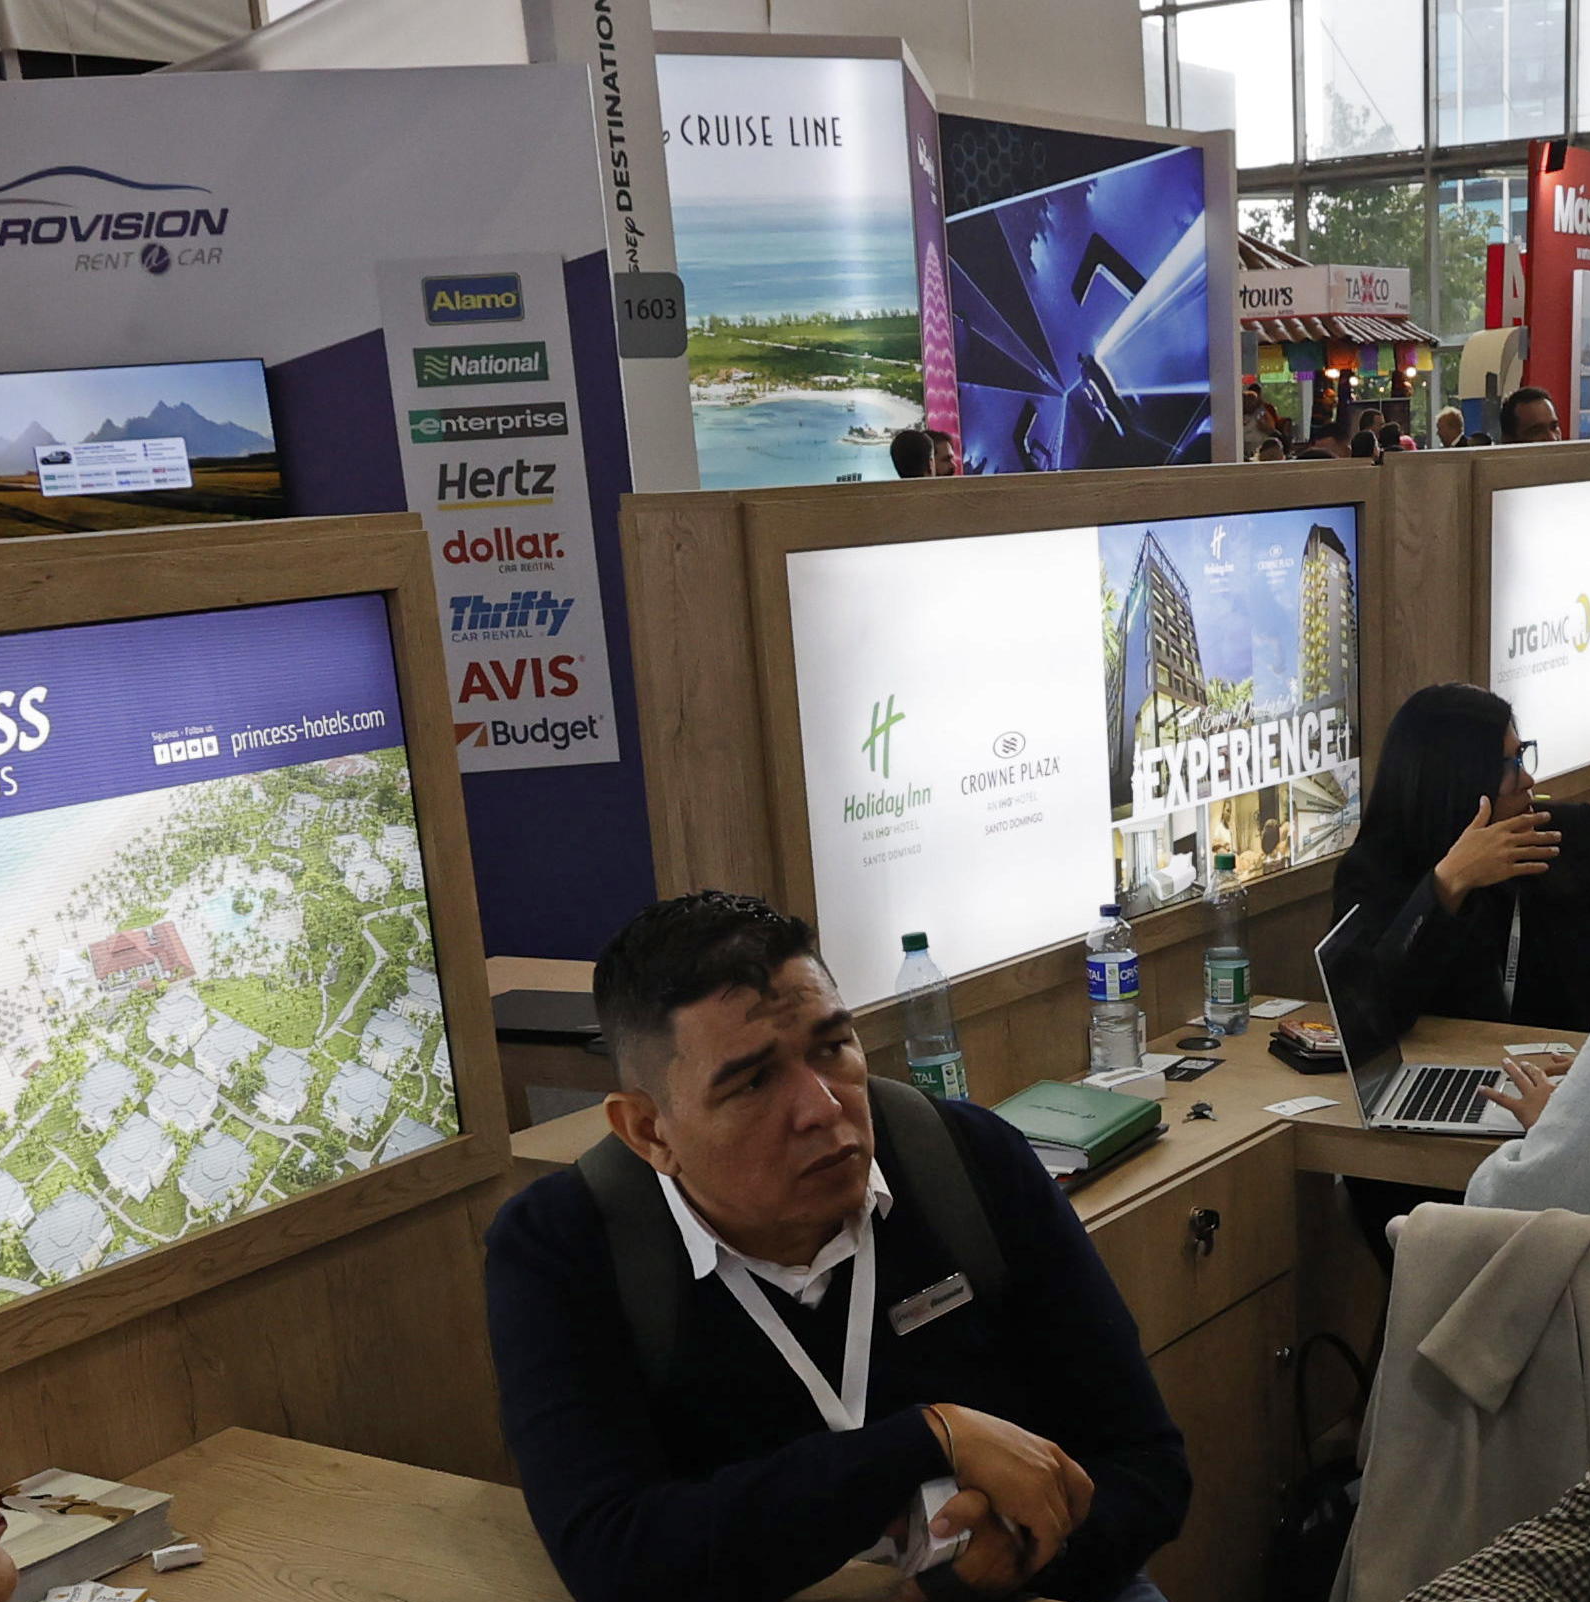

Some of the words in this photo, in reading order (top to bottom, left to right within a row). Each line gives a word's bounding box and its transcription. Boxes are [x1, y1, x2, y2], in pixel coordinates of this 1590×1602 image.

[680, 114, 774, 147] CRUISE
[789, 115, 843, 147] LINE
[75, 251, 134, 272] RENT
[177, 246, 223, 267] CAR
[432, 290, 517, 311] Alamo
[624, 298, 677, 321] 1603
[1238, 283, 1293, 309] tours
[449, 351, 540, 377] National
[413, 409, 565, 436] enterprise
[437, 459, 557, 501] Hertz
[498, 565, 519, 574] CAR
[520, 562, 556, 572] RENTAL
[449, 590, 575, 637] Thrifty
[451, 630, 479, 643] CAR
[482, 627, 533, 641] RENTAL
[1507, 623, 1539, 660] JTG
[1541, 614, 1570, 650] DMC
[458, 654, 580, 704] AVIS
[230, 708, 386, 758] princess-hotels.com
[491, 715, 599, 751] Budget
[1141, 706, 1338, 810] EXPERIENCE
[960, 764, 1016, 796] CROWNE
[1020, 755, 1060, 782] PLAZA
[843, 788, 905, 824] Holiday
[907, 781, 932, 810] Inn
[984, 819, 1009, 836] SANTO
[1009, 811, 1043, 830] DOMINGO
[862, 850, 887, 868] SANTO
[888, 843, 922, 860] DOMINGO
